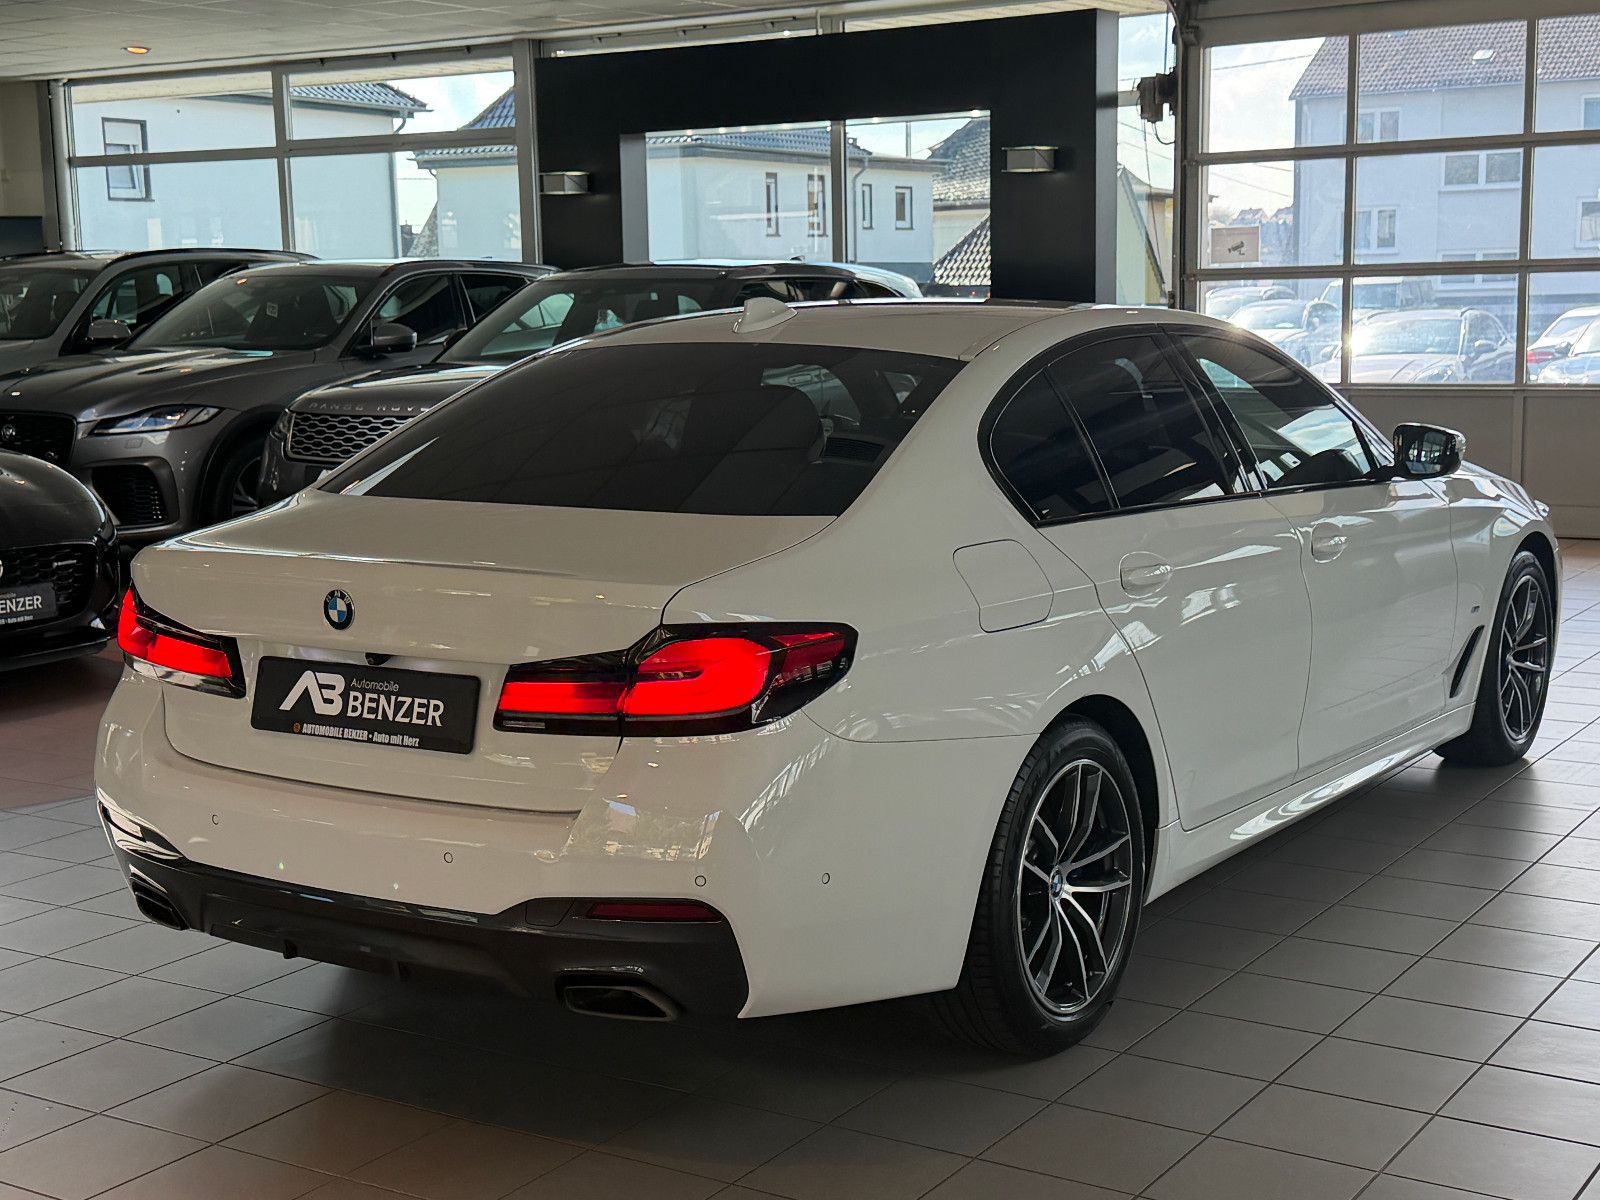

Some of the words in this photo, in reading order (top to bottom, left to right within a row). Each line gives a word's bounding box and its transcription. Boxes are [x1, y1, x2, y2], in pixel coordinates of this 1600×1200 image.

[308, 402, 364, 411] RANGE
[0, 595, 42, 614] ENZER
[278, 669, 346, 716] AB
[350, 678, 399, 692] Automobile
[346, 690, 445, 727] BENZER
[302, 722, 343, 738] AUTOMOBILE
[343, 728, 368, 742] BENZER
[372, 731, 390, 744] Auto
[390, 734, 403, 746] mit
[403, 735, 419, 748] Herz
